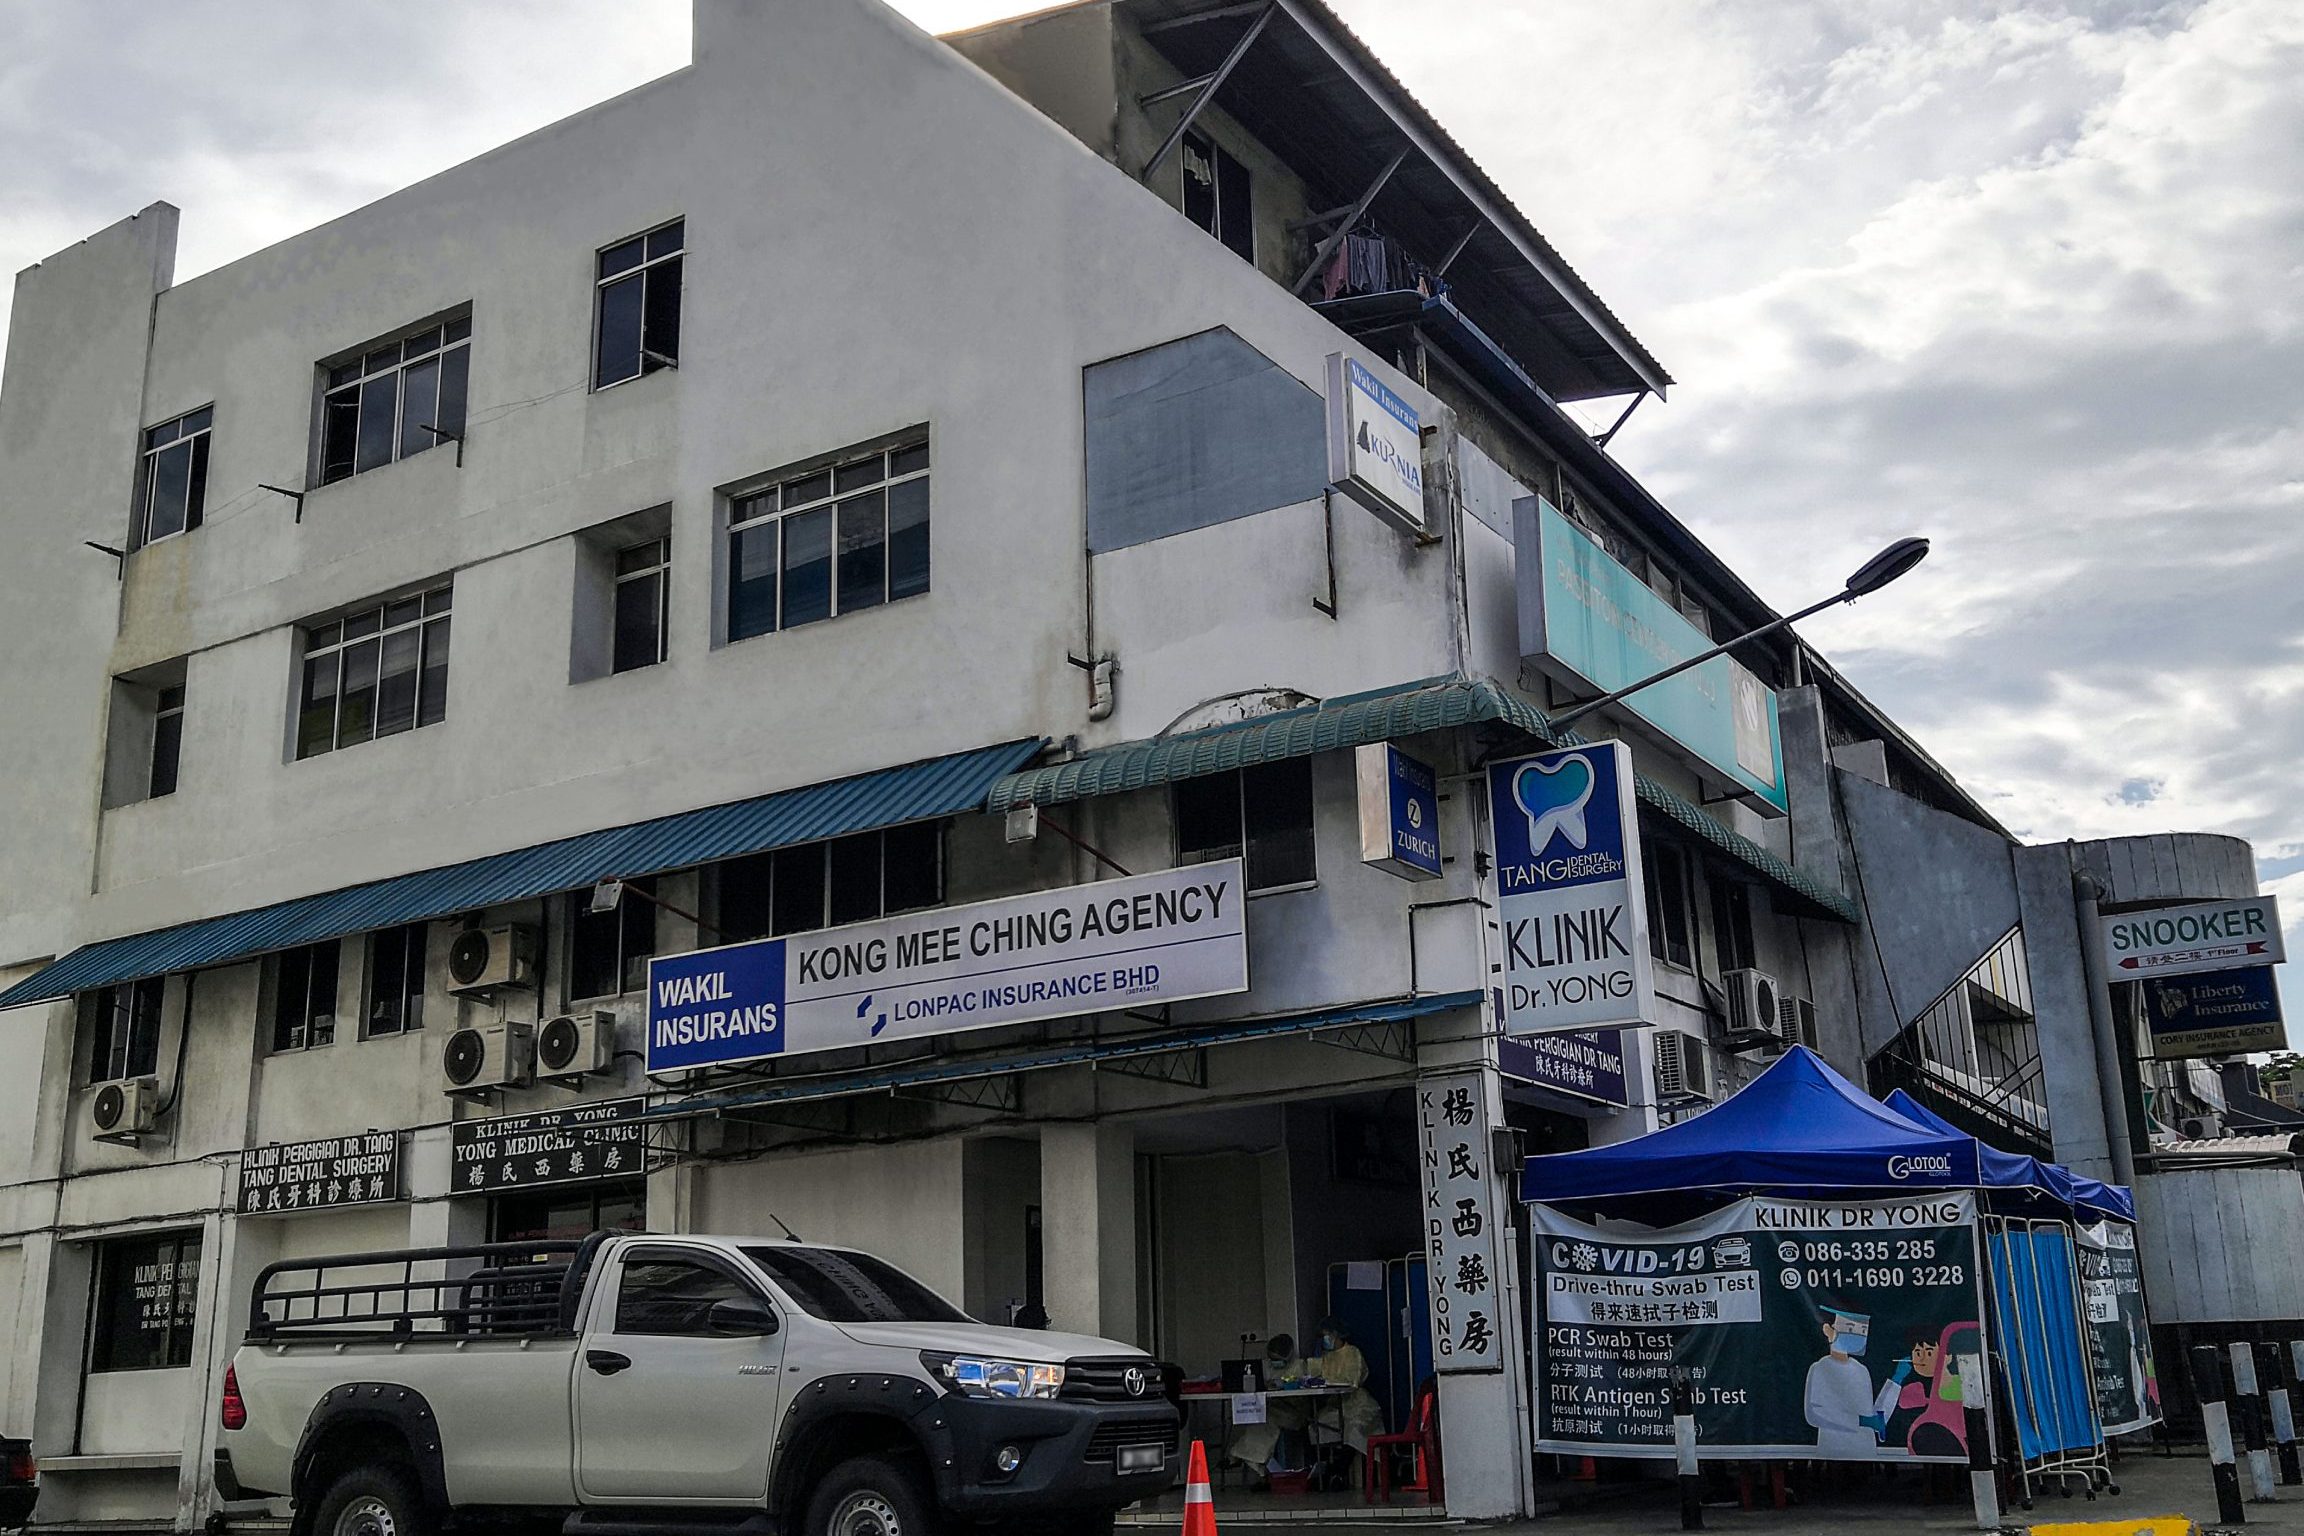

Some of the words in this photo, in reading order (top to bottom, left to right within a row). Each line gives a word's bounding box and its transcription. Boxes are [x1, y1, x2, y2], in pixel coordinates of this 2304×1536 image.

[1352, 364, 1379, 398] Wakil
[1370, 432, 1421, 488] KURNIA
[1397, 829, 1436, 860] ZURICH
[1571, 851, 1613, 868] DENTAL
[1571, 860, 1623, 879] SURGERY
[1500, 859, 1568, 888] TANG
[799, 938, 887, 985] KONG
[896, 925, 961, 970] MEE
[969, 907, 1073, 957] CHING
[1079, 881, 1228, 941] AGENCY
[1506, 904, 1630, 971] KLINIK
[2112, 907, 2267, 951] SNOOKER
[2218, 948, 2239, 956] Floor
[658, 971, 733, 1009] WAKIL
[894, 991, 977, 1022] LONPAC
[982, 971, 1107, 1010] INSURANCE
[1113, 964, 1160, 990] BHD
[2192, 982, 2247, 1000] Liberty
[2194, 999, 2270, 1017] Insurance
[655, 1002, 777, 1048] INSURANS
[2186, 1030, 2237, 1043] INSURANCE
[2239, 1025, 2275, 1038] AGENCY
[1583, 1045, 1597, 1068] DR
[1597, 1050, 1621, 1075] TANG
[476, 1118, 531, 1139] KLINIK
[243, 1147, 280, 1170] KLINIK
[283, 1140, 340, 1167] PERGIGIAN
[344, 1136, 362, 1158] DR.
[364, 1133, 394, 1154] TANG
[456, 1141, 497, 1162] YONG
[503, 1131, 576, 1157] MEDICAL
[243, 1167, 275, 1189] TANG
[279, 1161, 328, 1185] DENTAL
[333, 1153, 393, 1178] SURGERY
[468, 1146, 623, 1187] 楊氏西藥房
[1887, 1154, 1951, 1180] GLOTOOL
[247, 1174, 385, 1212] 陳氏牙科診療所
[1420, 1091, 1442, 1210] KLINIK
[1434, 1275, 1453, 1357] YONG
[1441, 1087, 1494, 1355] 楊氏西藥房
[1755, 1207, 1832, 1228] KLINIK
[1841, 1208, 1874, 1228] DR
[1882, 1202, 1961, 1226] YONG
[1804, 1241, 1889, 1262] 086-335
[1896, 1239, 1936, 1260] 285
[1553, 1276, 1644, 1297] Drive-thru
[1651, 1278, 1708, 1297] Swab
[1713, 1274, 1755, 1293] Test
[1806, 1267, 1904, 1288] 011-1690
[1912, 1265, 1965, 1286] 3228
[136, 1286, 155, 1299] TANG
[1591, 1299, 1719, 1322] 得来速拭子检测
[1548, 1327, 1581, 1346] PCR
[1586, 1329, 1632, 1347] Swab
[1634, 1331, 1675, 1348] Test
[1549, 1346, 1582, 1359] (result
[1584, 1347, 1619, 1360] within
[1621, 1349, 1636, 1360] 48
[1638, 1348, 1674, 1362] hours)
[1550, 1362, 1604, 1379] 分子测试
[1551, 1383, 1580, 1402] RTK
[1584, 1386, 1656, 1409] Antigen
[1660, 1387, 1706, 1405] Sb
[1710, 1387, 1748, 1405] Test
[1551, 1402, 1581, 1416] (result
[1583, 1404, 1620, 1417] within
[1632, 1406, 1663, 1420] hour)
[1552, 1417, 1604, 1435] 抗原测试
